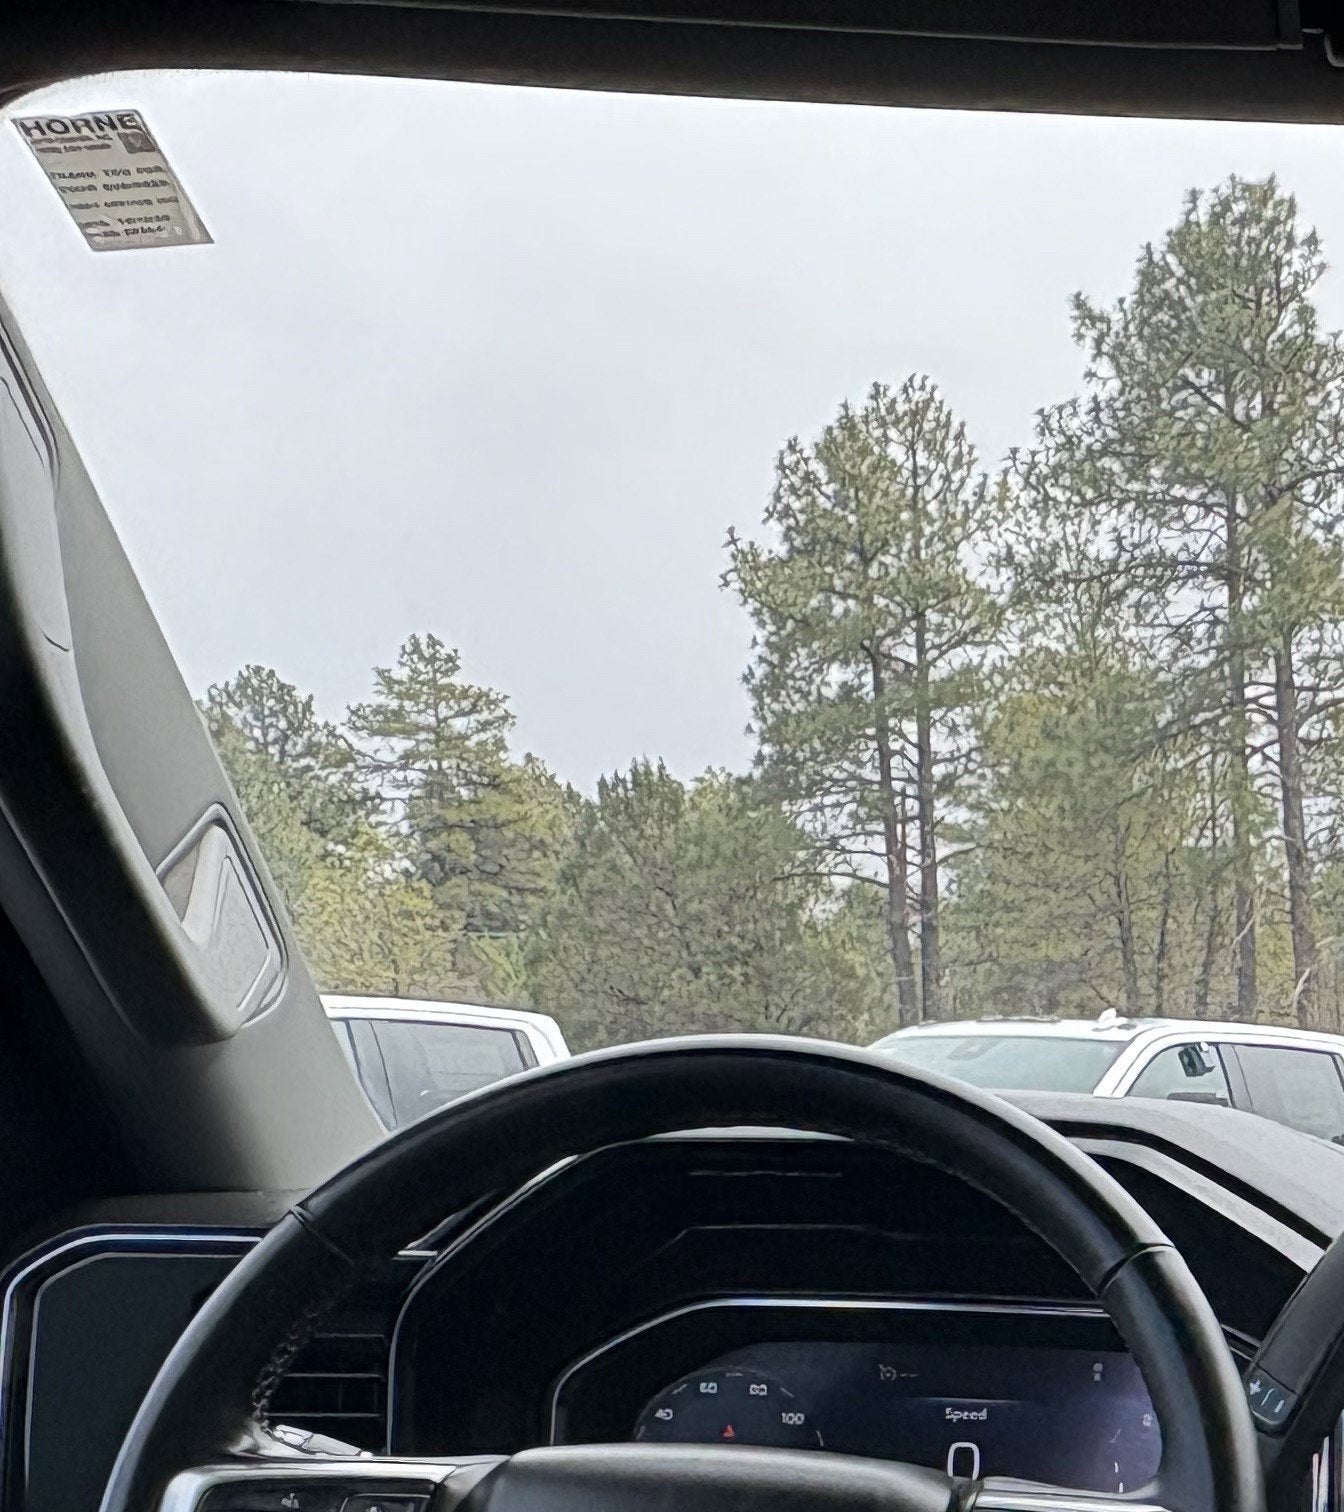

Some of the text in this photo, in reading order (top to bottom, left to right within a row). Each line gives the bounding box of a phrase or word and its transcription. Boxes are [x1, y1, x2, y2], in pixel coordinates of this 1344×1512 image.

[19, 113, 143, 138] HORNE
[781, 1412, 805, 1425] 100
[945, 1407, 988, 1423] Speed
